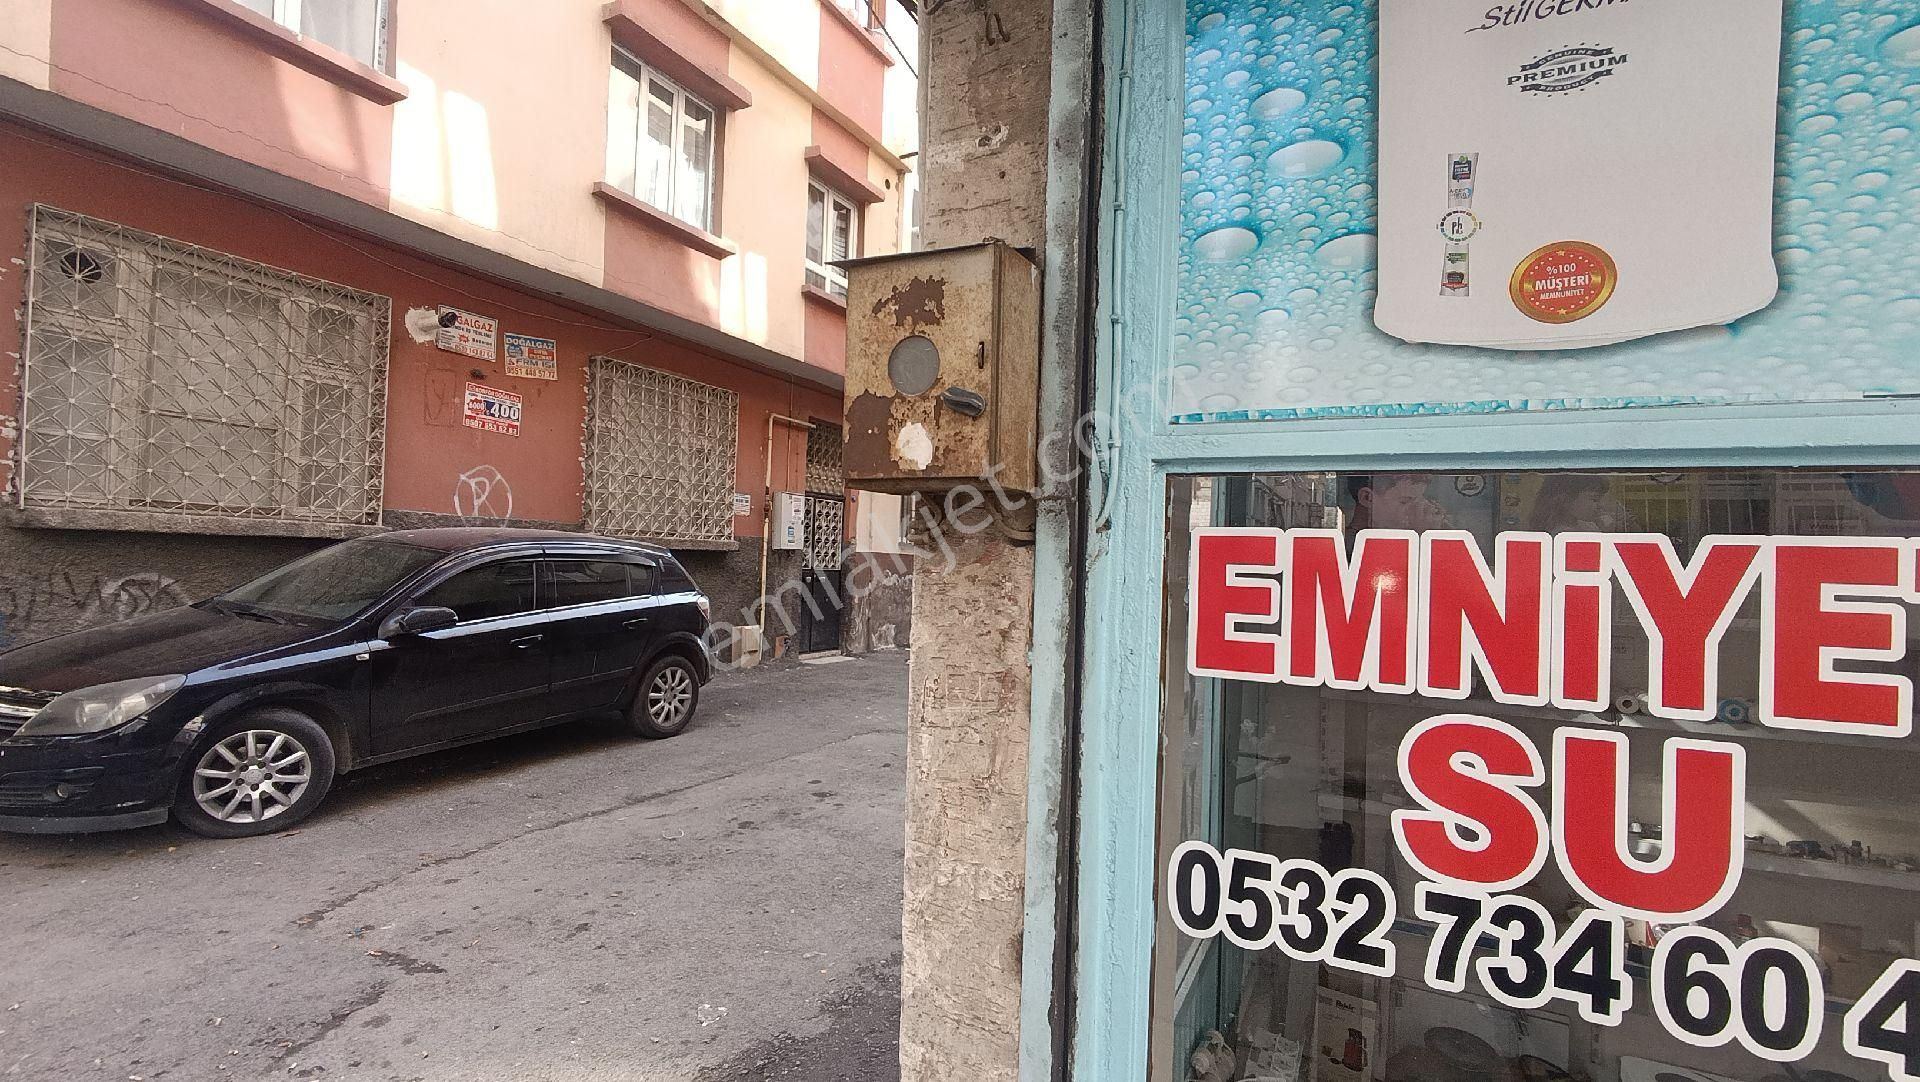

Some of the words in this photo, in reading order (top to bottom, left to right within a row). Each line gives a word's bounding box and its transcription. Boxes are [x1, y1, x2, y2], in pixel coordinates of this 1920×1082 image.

[1507, 54, 1629, 85] PREMIUM
[1535, 271, 1589, 291] MÜŞTERİ
[1546, 263, 1576, 275] %100
[505, 337, 554, 350] DOĞALGAZ
[1192, 531, 1920, 734] EMNİYE
[1396, 719, 1740, 919] SU
[1172, 845, 1392, 973] 0532
[1420, 887, 1626, 1021] 734
[1657, 930, 1817, 1057] 60
